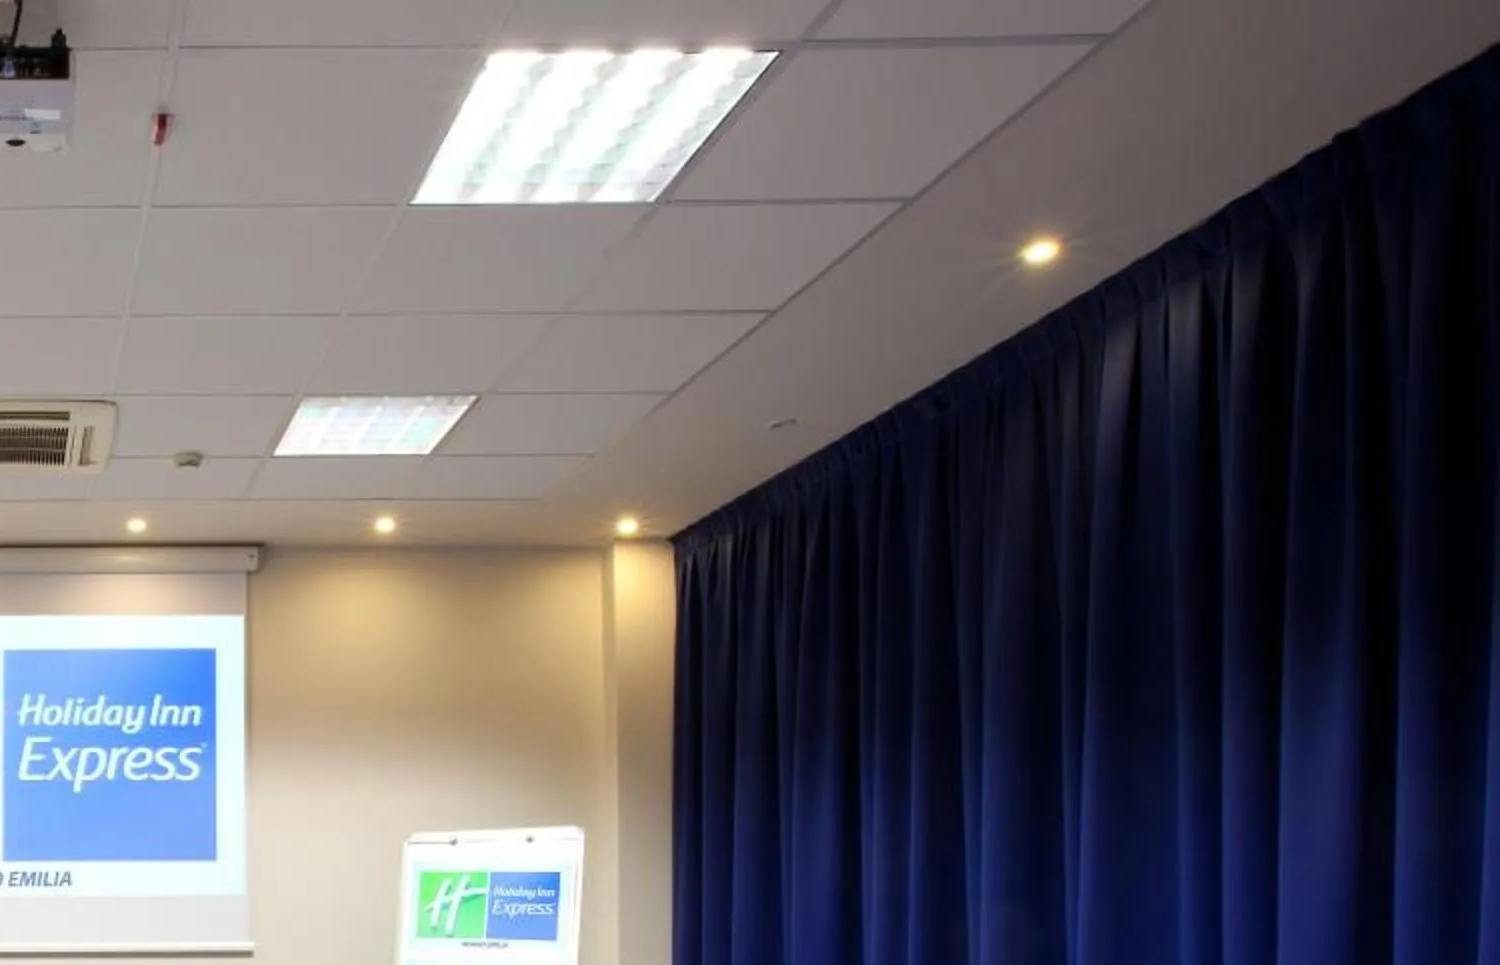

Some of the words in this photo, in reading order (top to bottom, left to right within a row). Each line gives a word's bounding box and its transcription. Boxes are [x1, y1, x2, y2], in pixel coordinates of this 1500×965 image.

[18, 693, 146, 734] Holiday
[150, 693, 203, 727] Inn
[18, 736, 203, 793] Express
[7, 871, 73, 888] EMILIA
[492, 900, 555, 919] Express
